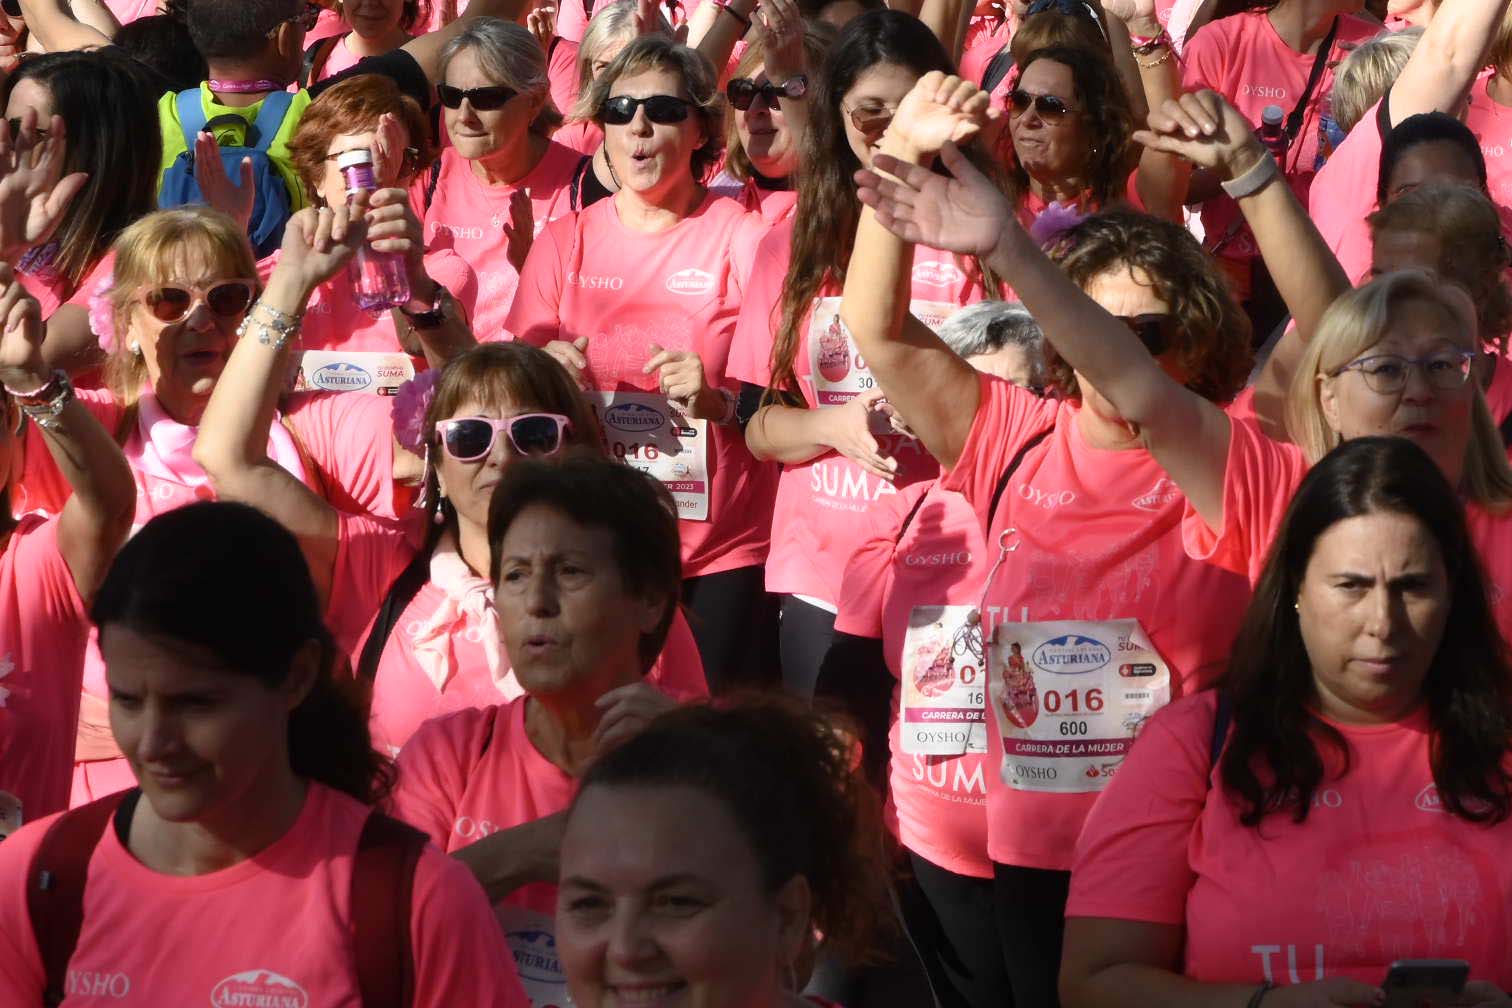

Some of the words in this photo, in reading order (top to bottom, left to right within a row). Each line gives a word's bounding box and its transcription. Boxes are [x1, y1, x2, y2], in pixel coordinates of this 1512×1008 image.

[317, 373, 367, 385] ASTURIANA
[376, 370, 405, 378] SUMA
[613, 441, 659, 460] 016
[1038, 649, 1106, 666] ASTURIANA
[1043, 688, 1104, 713] 016
[921, 711, 963, 720] CARRERA
[966, 712, 979, 720] DE
[916, 730, 968, 743] OYSHO
[1059, 721, 1088, 736] 600
[1015, 743, 1055, 754] CARRERA
[1056, 744, 1070, 754] DE
[1072, 744, 1086, 753] LA
[1088, 742, 1125, 753] MUJER
[912, 753, 987, 795] SUM
[1015, 764, 1057, 780] OYSHO
[1251, 944, 1324, 984] TU
[66, 971, 131, 998] YSHO
